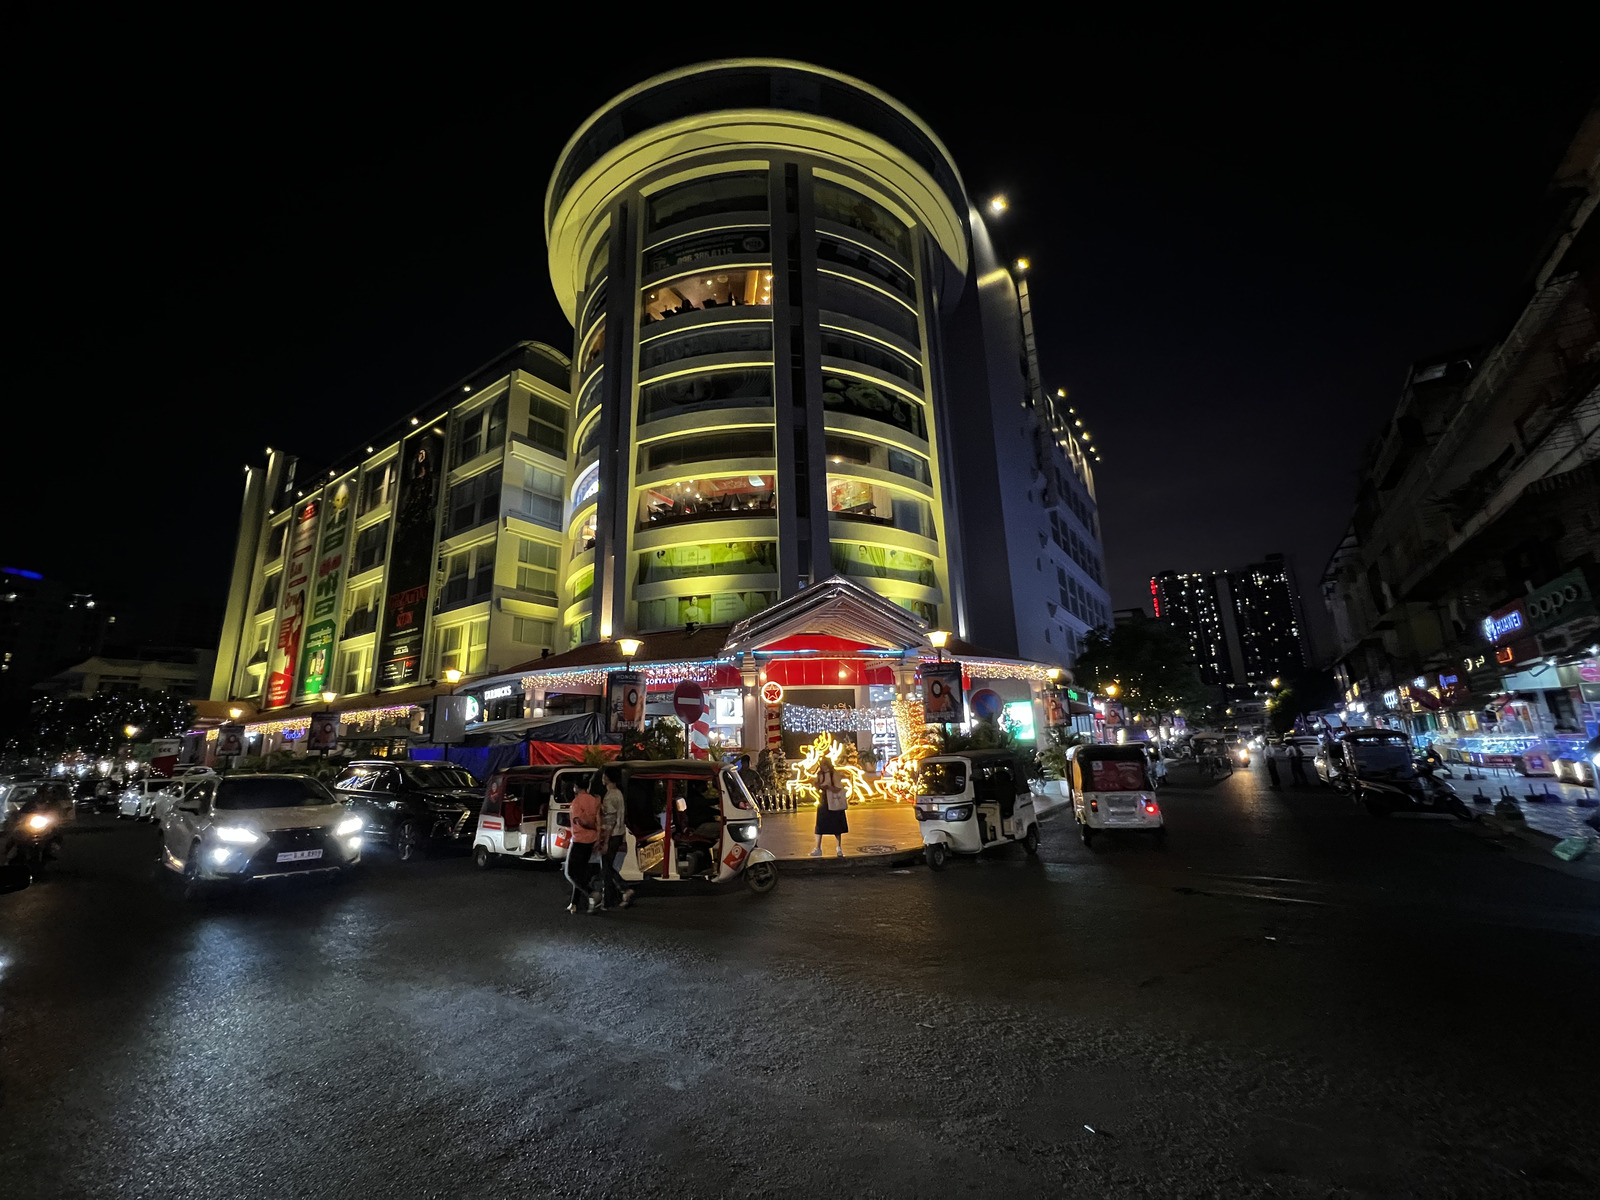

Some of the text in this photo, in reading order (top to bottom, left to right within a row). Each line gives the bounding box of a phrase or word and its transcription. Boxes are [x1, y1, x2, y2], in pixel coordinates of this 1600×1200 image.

[1495, 612, 1521, 635] HUAWEI
[615, 673, 637, 681] HONOR
[645, 677, 667, 686] SORYA
